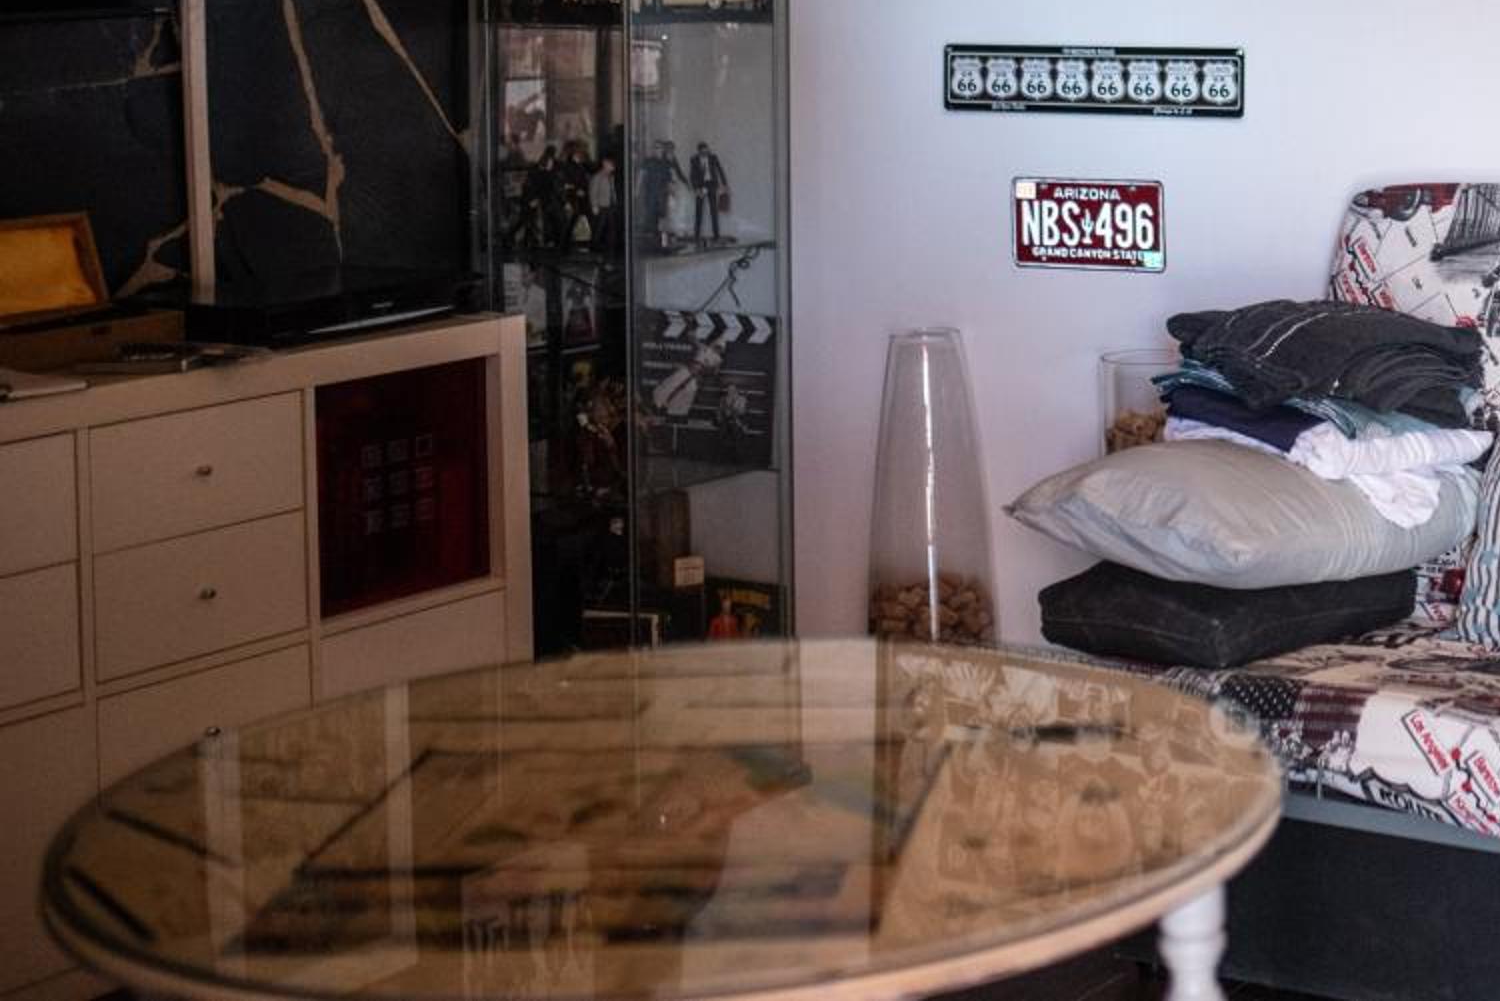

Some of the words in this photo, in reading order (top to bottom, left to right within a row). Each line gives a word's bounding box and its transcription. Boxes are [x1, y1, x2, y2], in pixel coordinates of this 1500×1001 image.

[957, 79, 977, 92] 66
[991, 79, 1011, 93] 66
[1026, 80, 1047, 94] 66
[1061, 80, 1082, 95] 66
[1097, 81, 1118, 96] 66
[1133, 82, 1155, 97] 66
[1170, 83, 1192, 98] 66
[1208, 84, 1230, 98] 66
[1053, 186, 1121, 201] ARIZONA
[1021, 199, 1081, 247] NBS
[1095, 202, 1154, 249] 496
[1032, 246, 1068, 258] GRAND
[1069, 248, 1112, 260] CANYON
[1410, 713, 1425, 732] Los
[1422, 731, 1449, 770] Angeles
